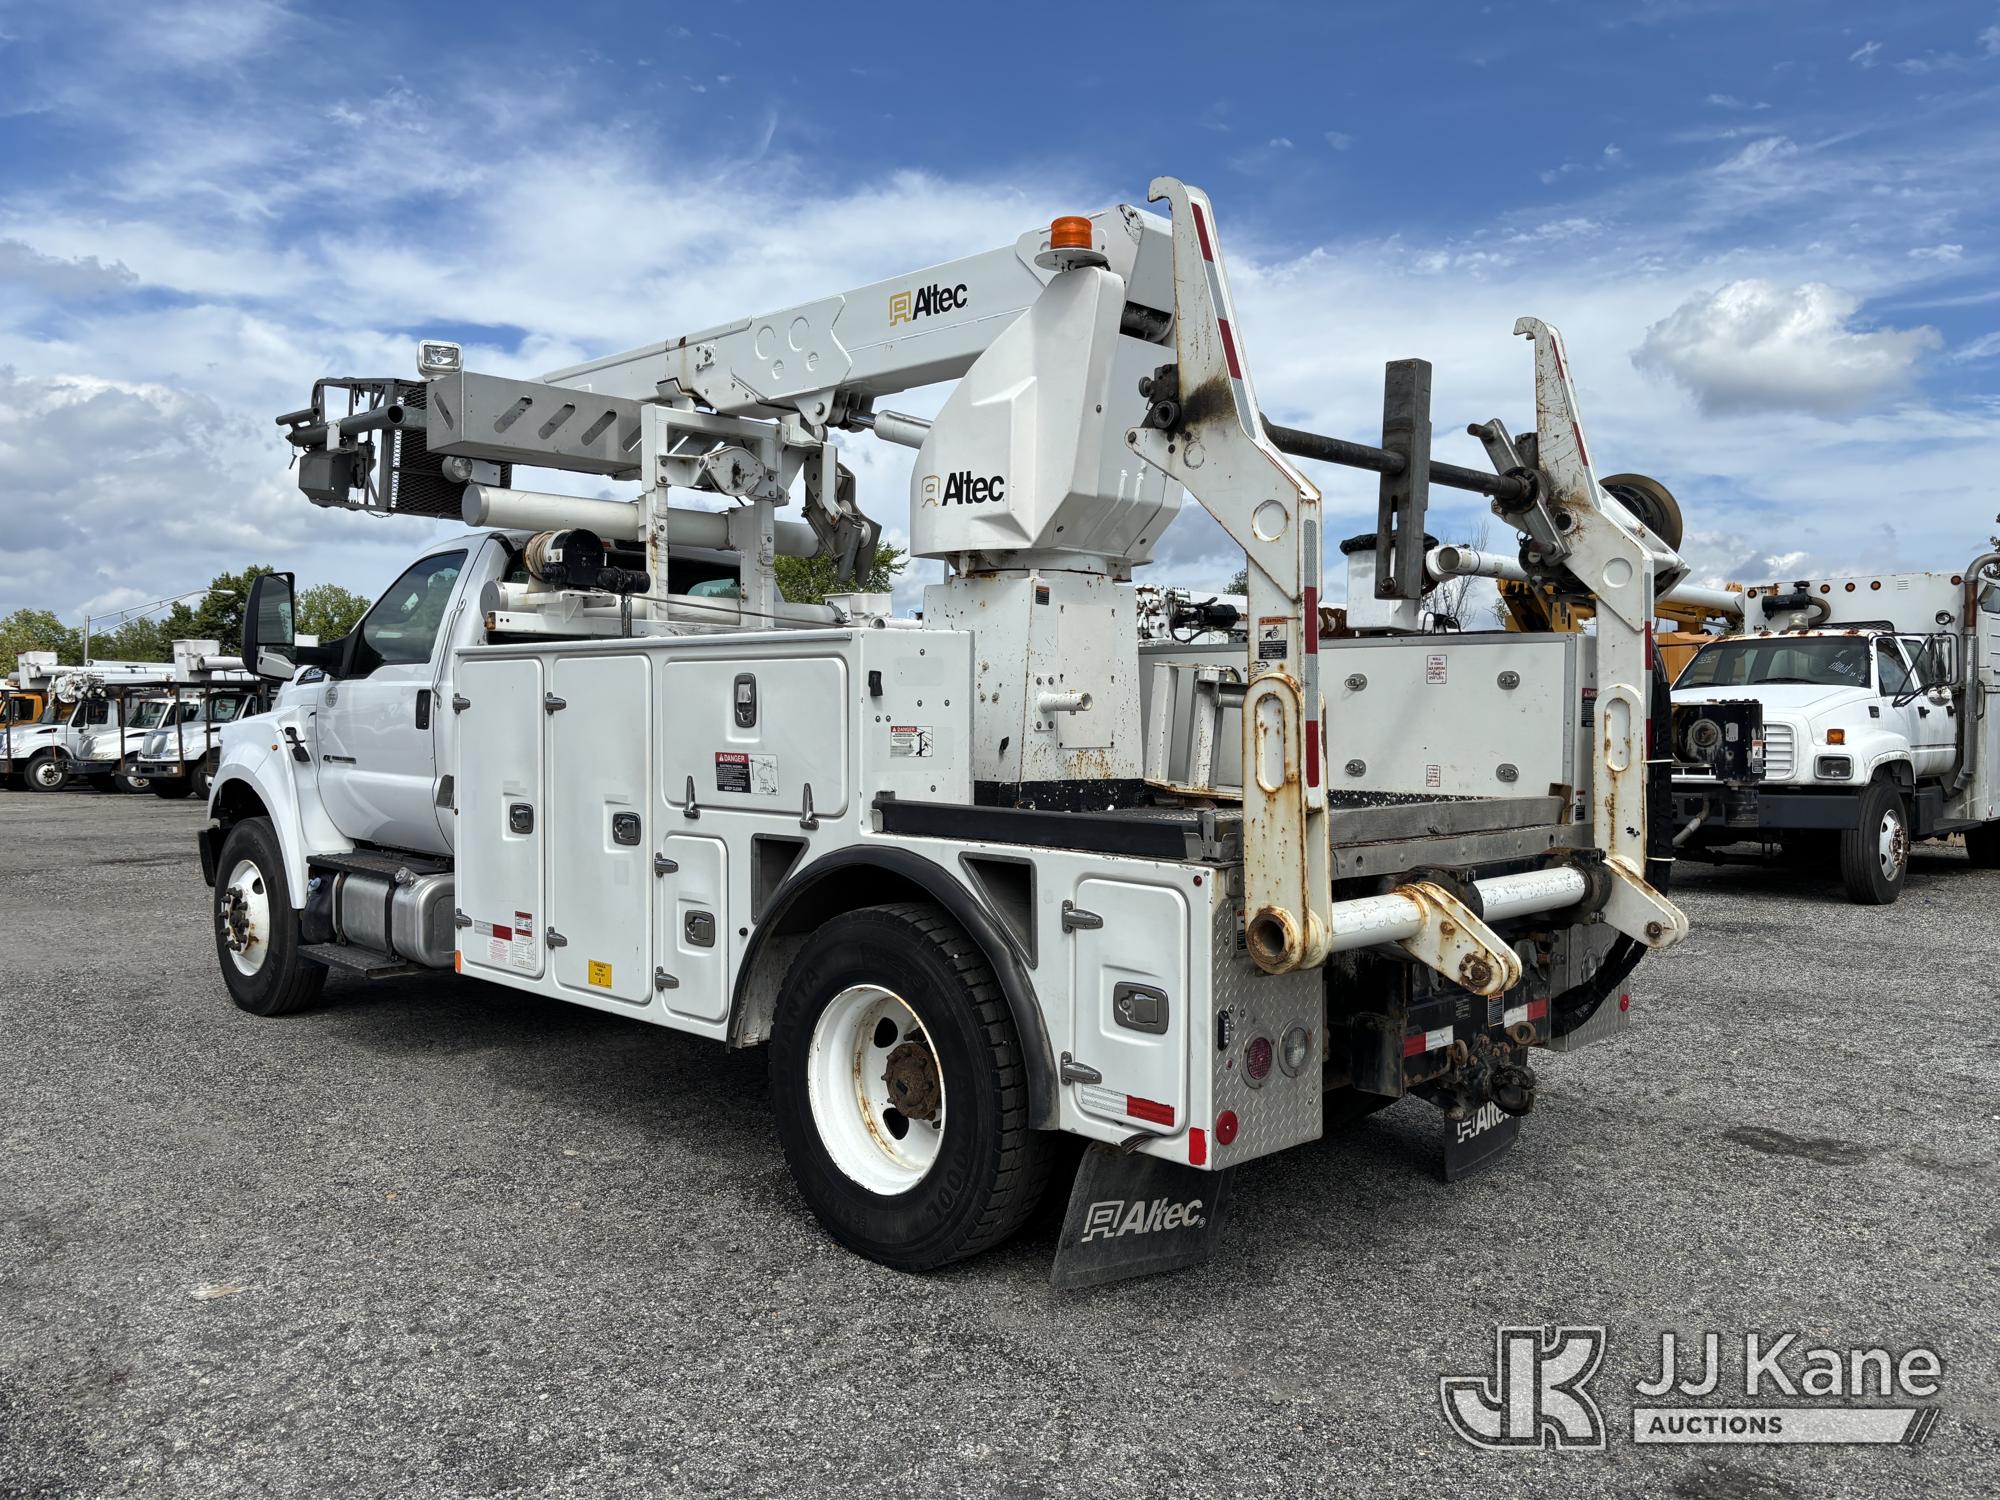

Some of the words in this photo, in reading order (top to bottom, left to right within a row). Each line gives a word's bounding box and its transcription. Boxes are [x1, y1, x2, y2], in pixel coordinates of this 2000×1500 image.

[912, 283, 968, 320] Altec
[942, 470, 1004, 506] Altec
[724, 754, 746, 763] DANGER
[1475, 1101, 1511, 1136] Alte
[1115, 1197, 1203, 1237] Altec
